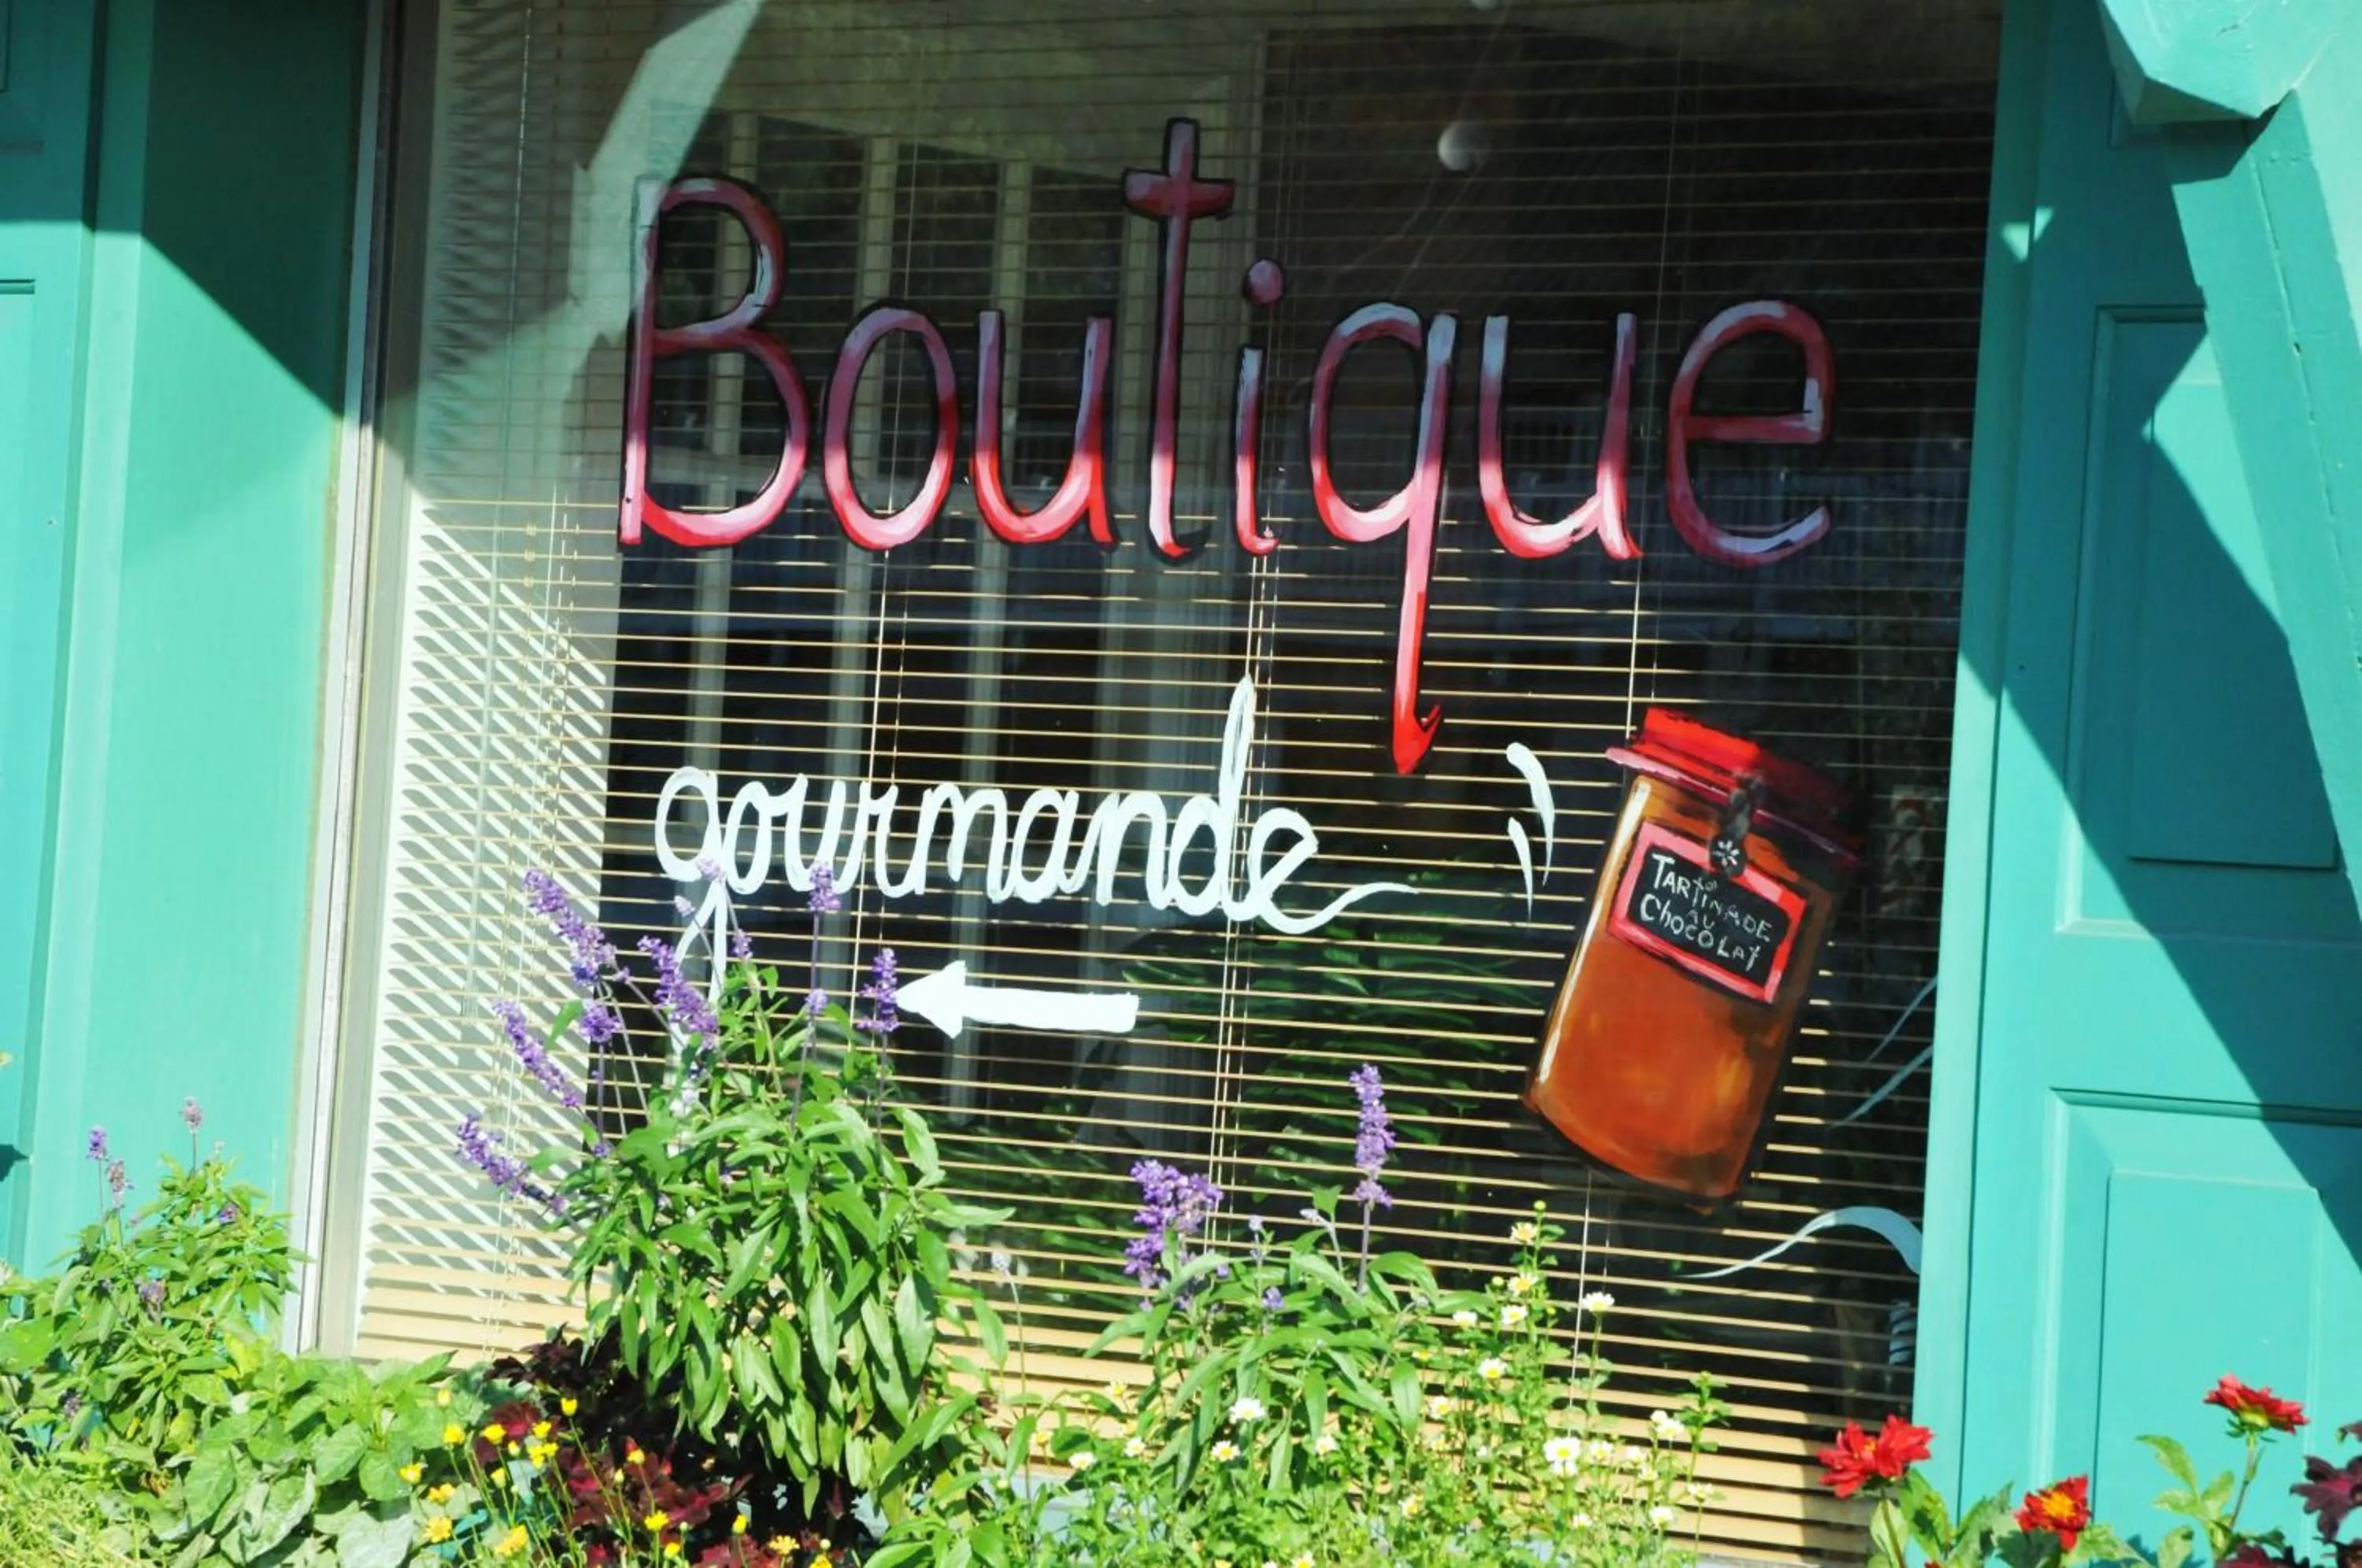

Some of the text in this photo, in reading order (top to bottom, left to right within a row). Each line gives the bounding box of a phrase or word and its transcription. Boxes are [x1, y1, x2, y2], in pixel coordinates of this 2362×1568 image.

[619, 118, 1834, 773] Boutique
[654, 675, 1420, 1056] gourmande
[1651, 852, 1773, 943] TARTINADE
